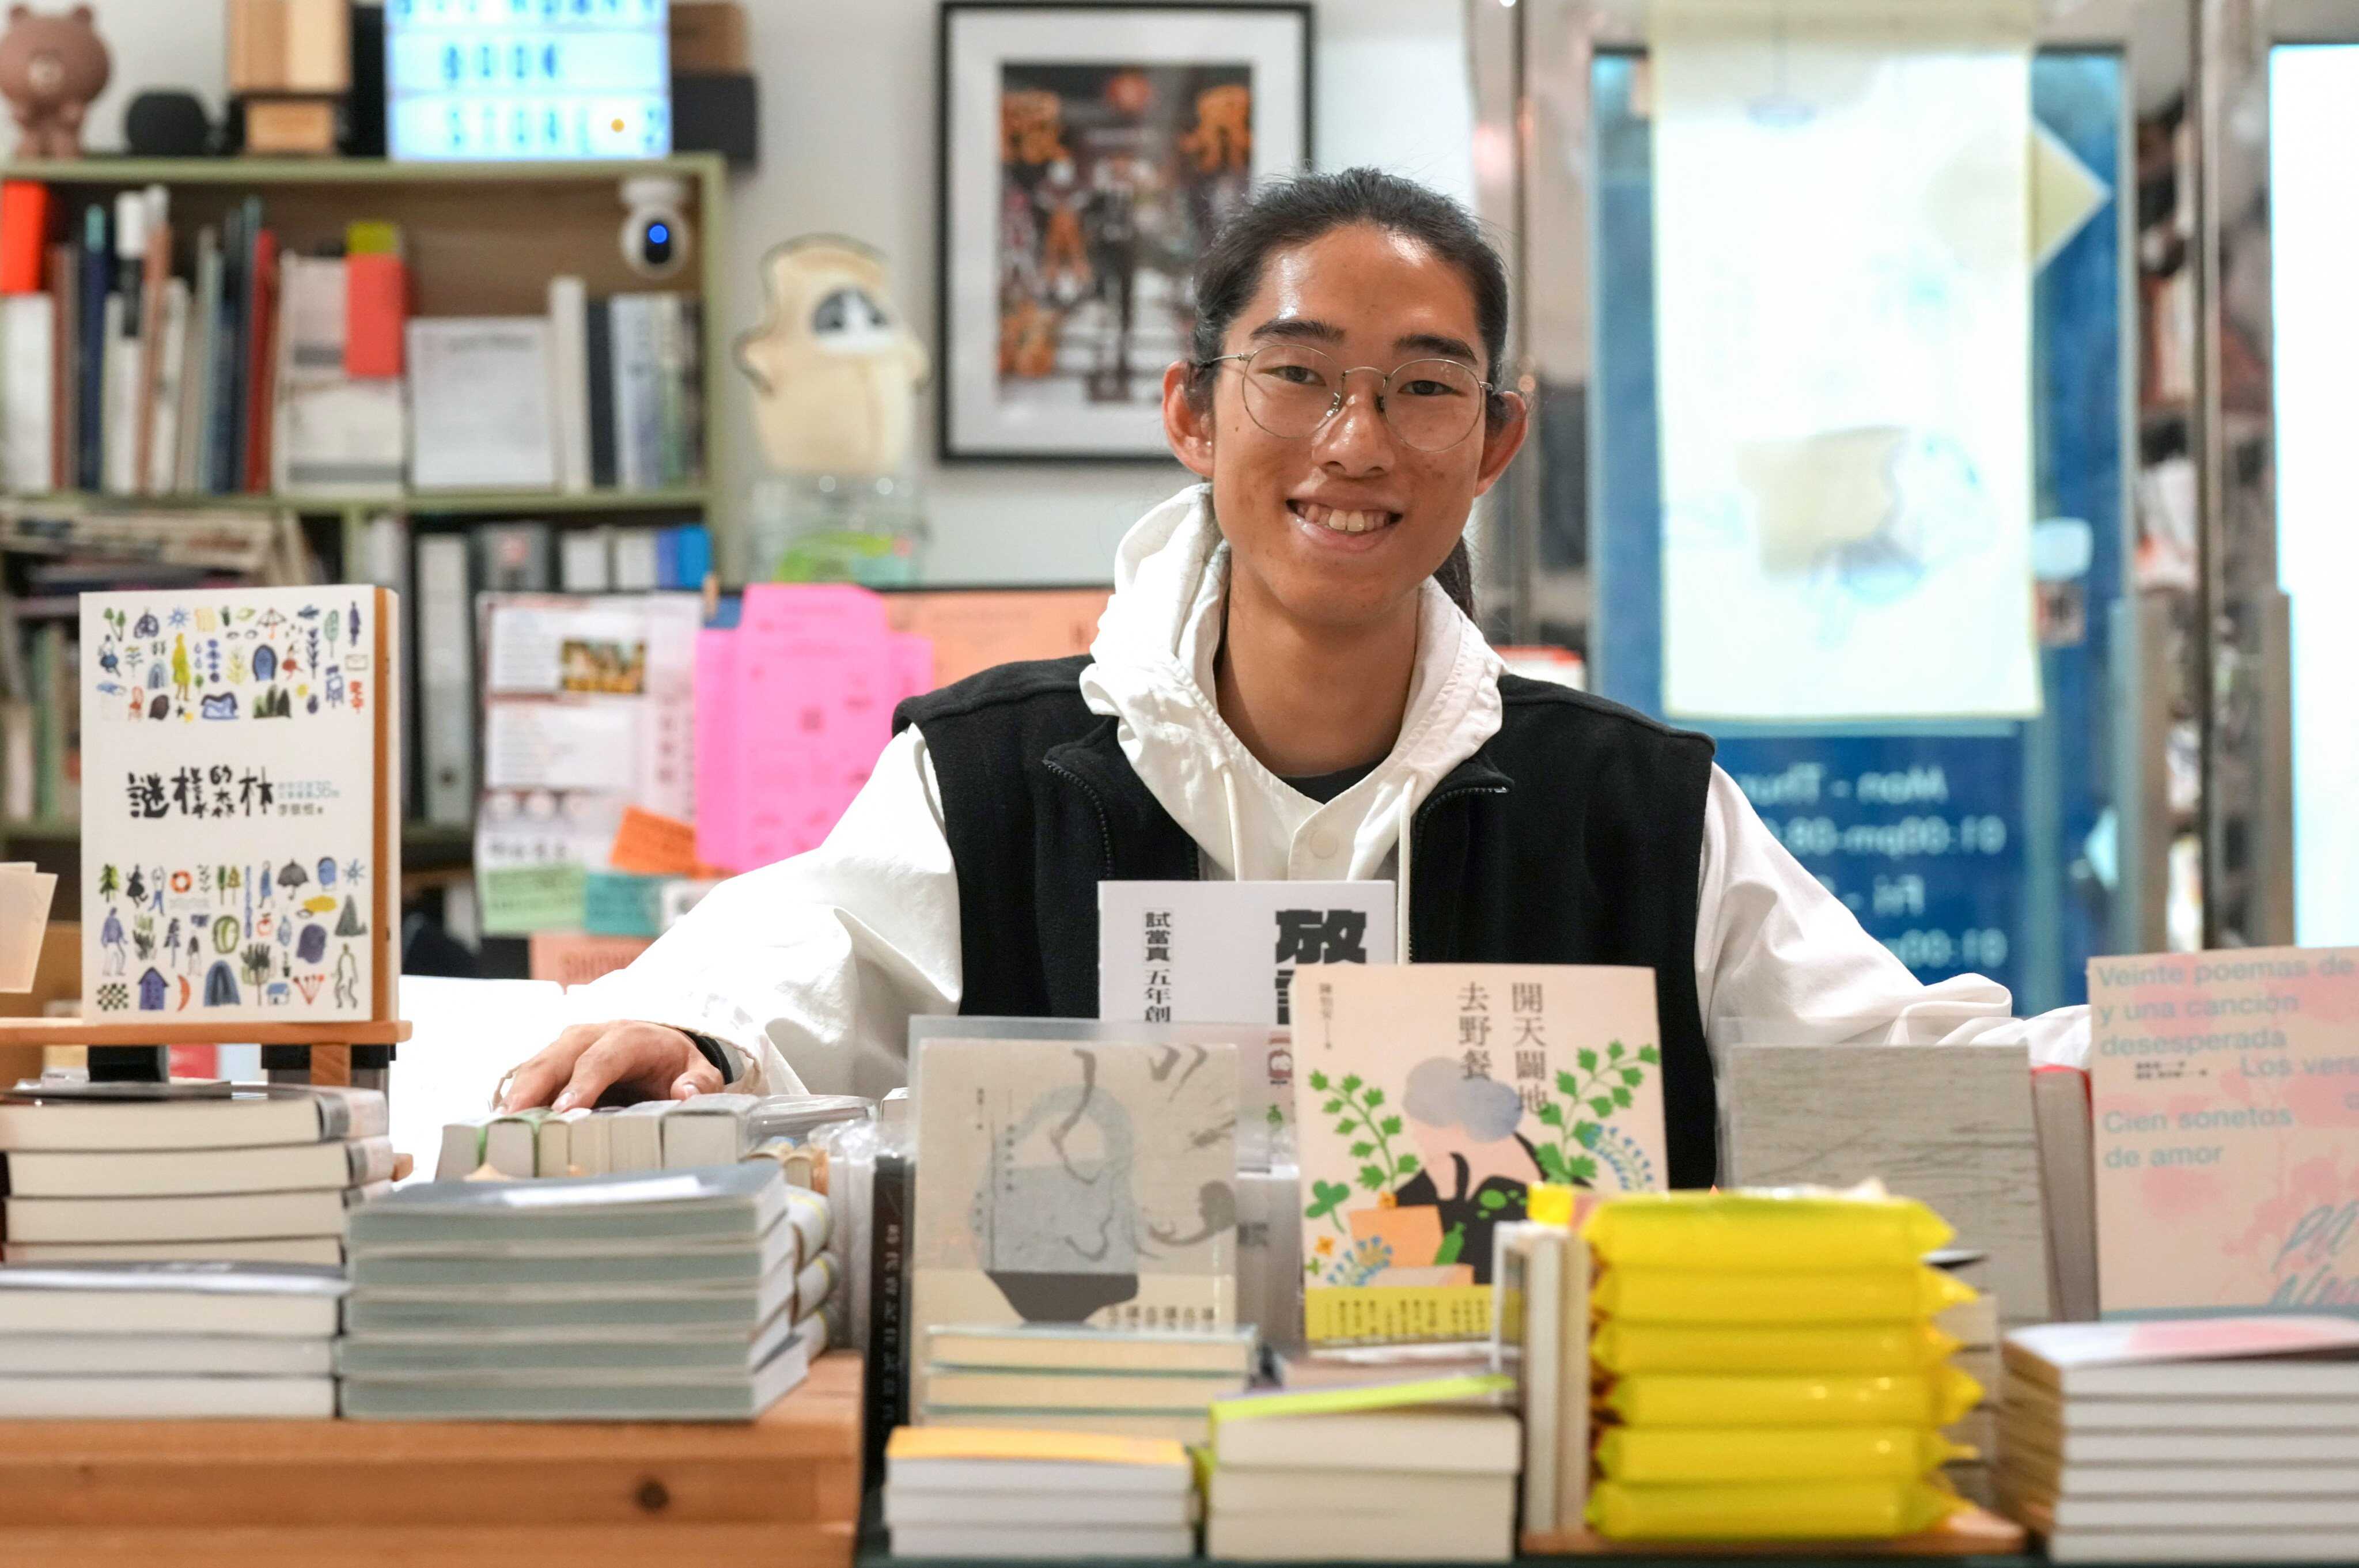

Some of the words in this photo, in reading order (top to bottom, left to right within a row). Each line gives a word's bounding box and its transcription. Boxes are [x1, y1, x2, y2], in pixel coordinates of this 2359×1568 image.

[2097, 962, 2185, 987] Veinte
[2194, 959, 2309, 986] poemas
[2318, 954, 2354, 976] de
[2099, 1003, 2114, 1025] y
[2125, 1001, 2175, 1021] una
[1457, 981, 1493, 1081] 去野餐
[2100, 1029, 2287, 1056] desesperada
[2241, 1054, 2292, 1077] Los
[2103, 1110, 2167, 1133] Cien
[2178, 1105, 2294, 1129] sonetos
[2103, 1146, 2139, 1168] de
[2150, 1145, 2222, 1168] amor
